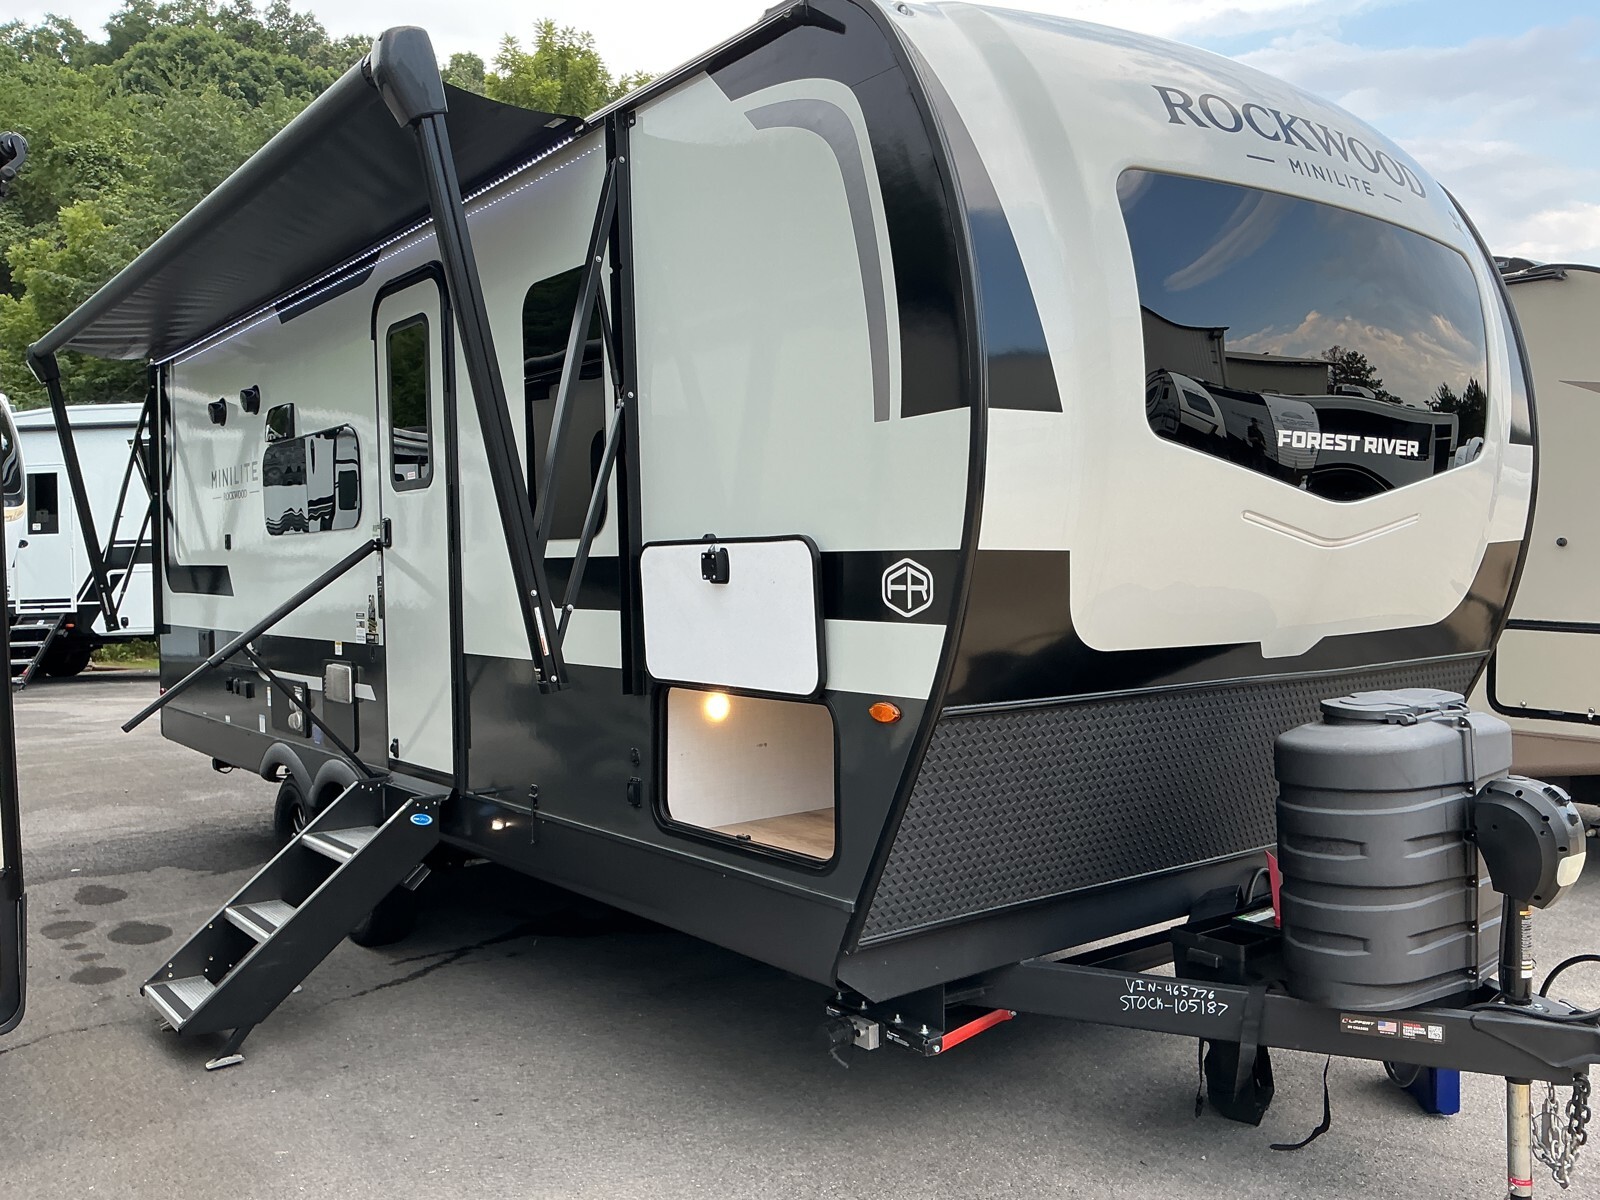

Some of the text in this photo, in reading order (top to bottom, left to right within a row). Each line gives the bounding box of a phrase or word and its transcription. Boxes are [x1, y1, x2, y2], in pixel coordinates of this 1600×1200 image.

[1152, 85, 1426, 198] ROCKWOOD
[1290, 158, 1374, 197] MINILITE
[1278, 430, 1419, 457] FOREST RIVER
[211, 461, 258, 488] MINILITE
[1125, 979, 1215, 998] VIN-465776
[1120, 995, 1229, 1016] STOCK-105187
